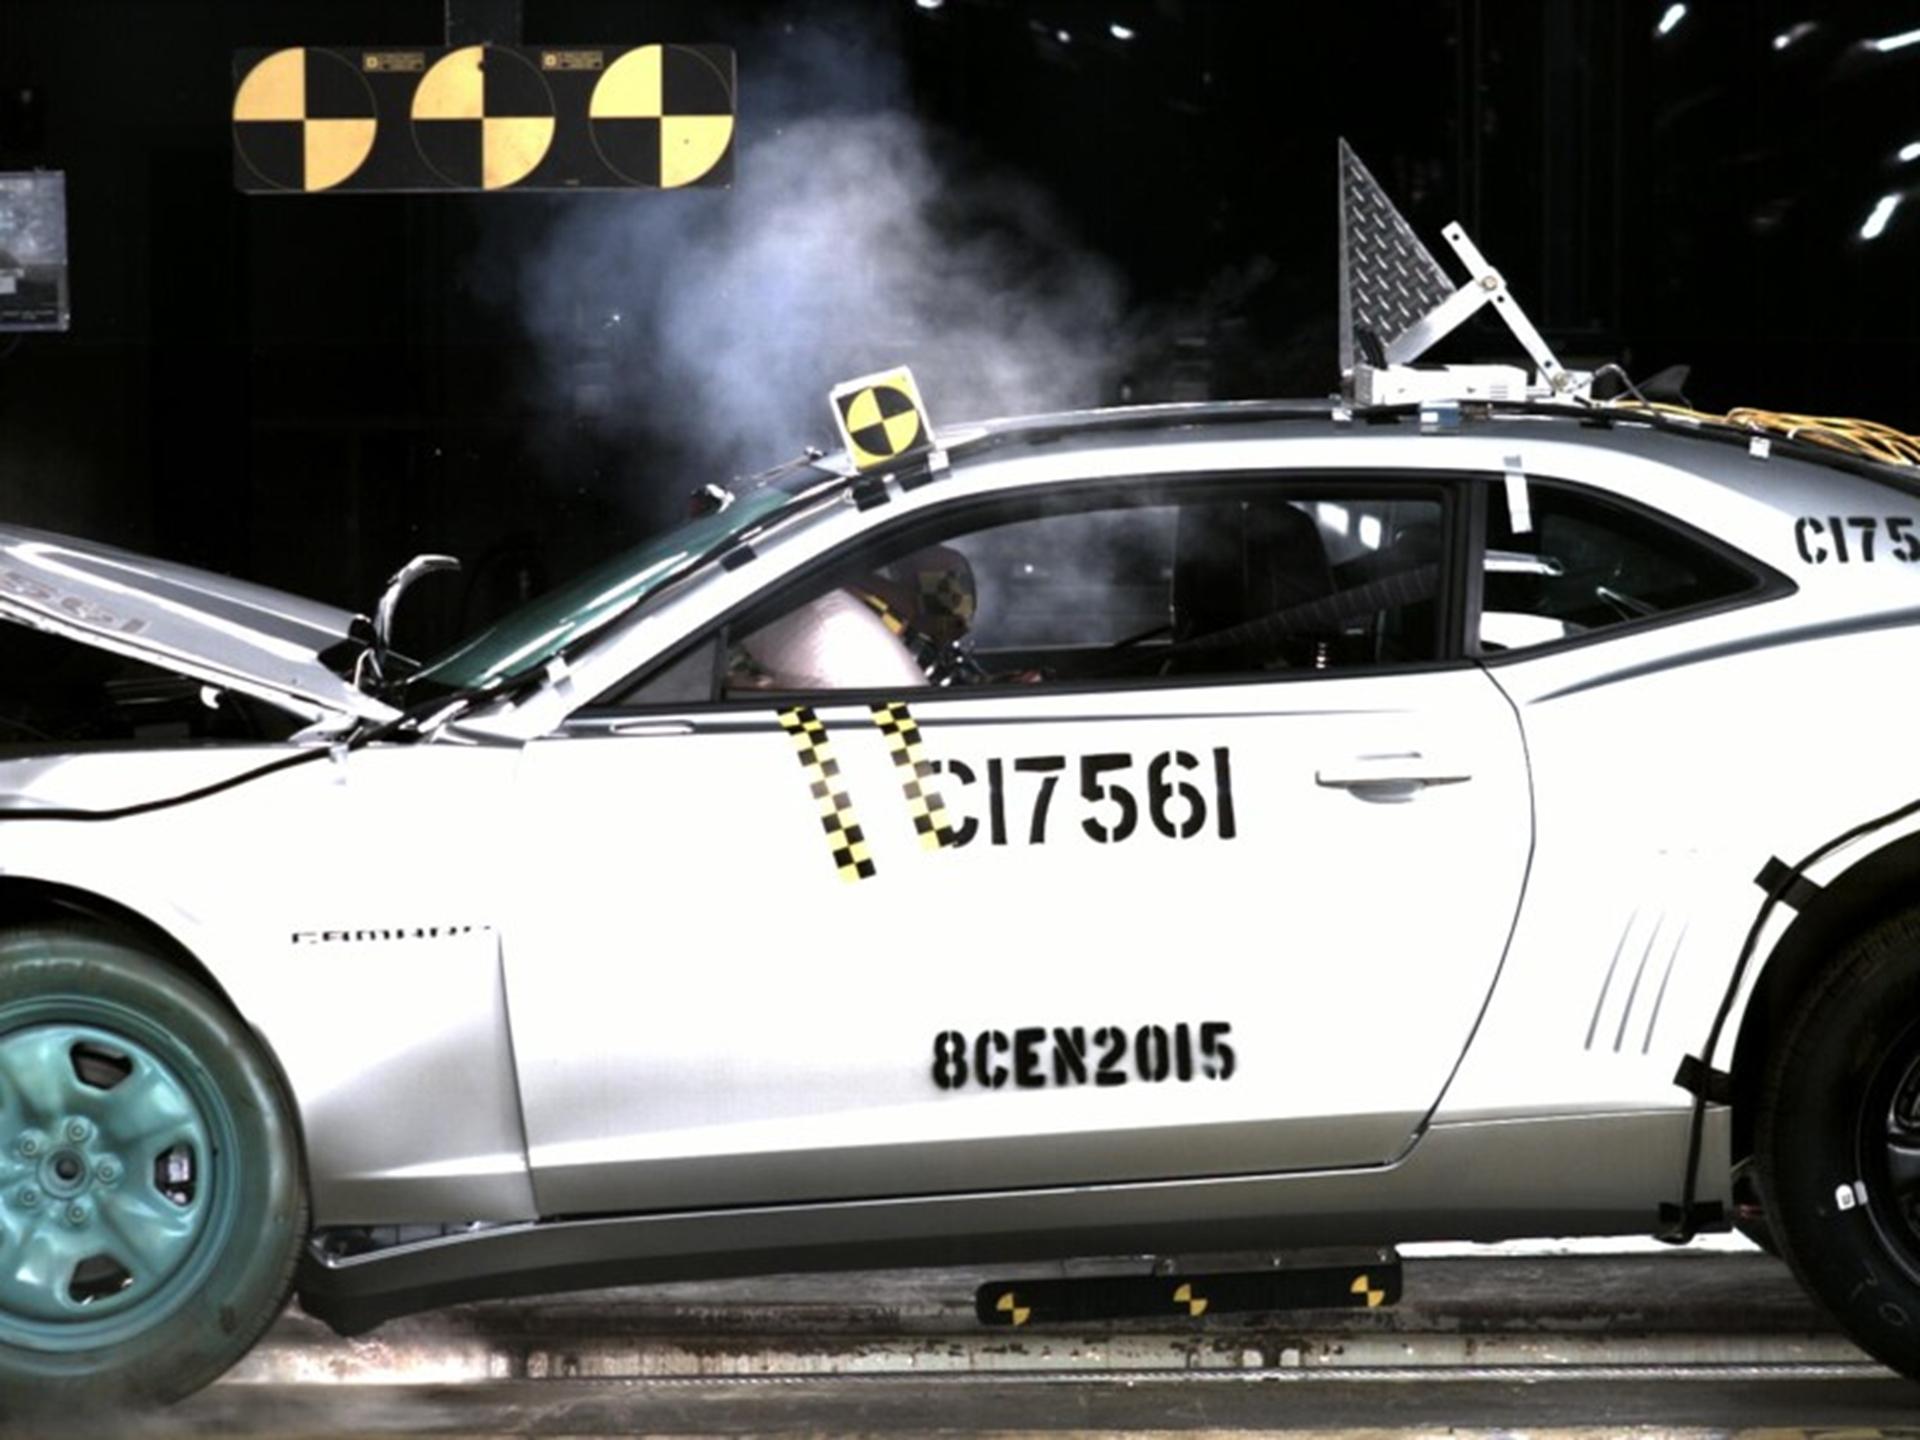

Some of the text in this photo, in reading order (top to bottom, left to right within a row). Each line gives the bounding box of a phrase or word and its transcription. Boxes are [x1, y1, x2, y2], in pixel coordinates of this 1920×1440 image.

[1795, 515, 1920, 564] C175
[929, 746, 1236, 848] C17561
[931, 1021, 1237, 1091] 8CEN2015
